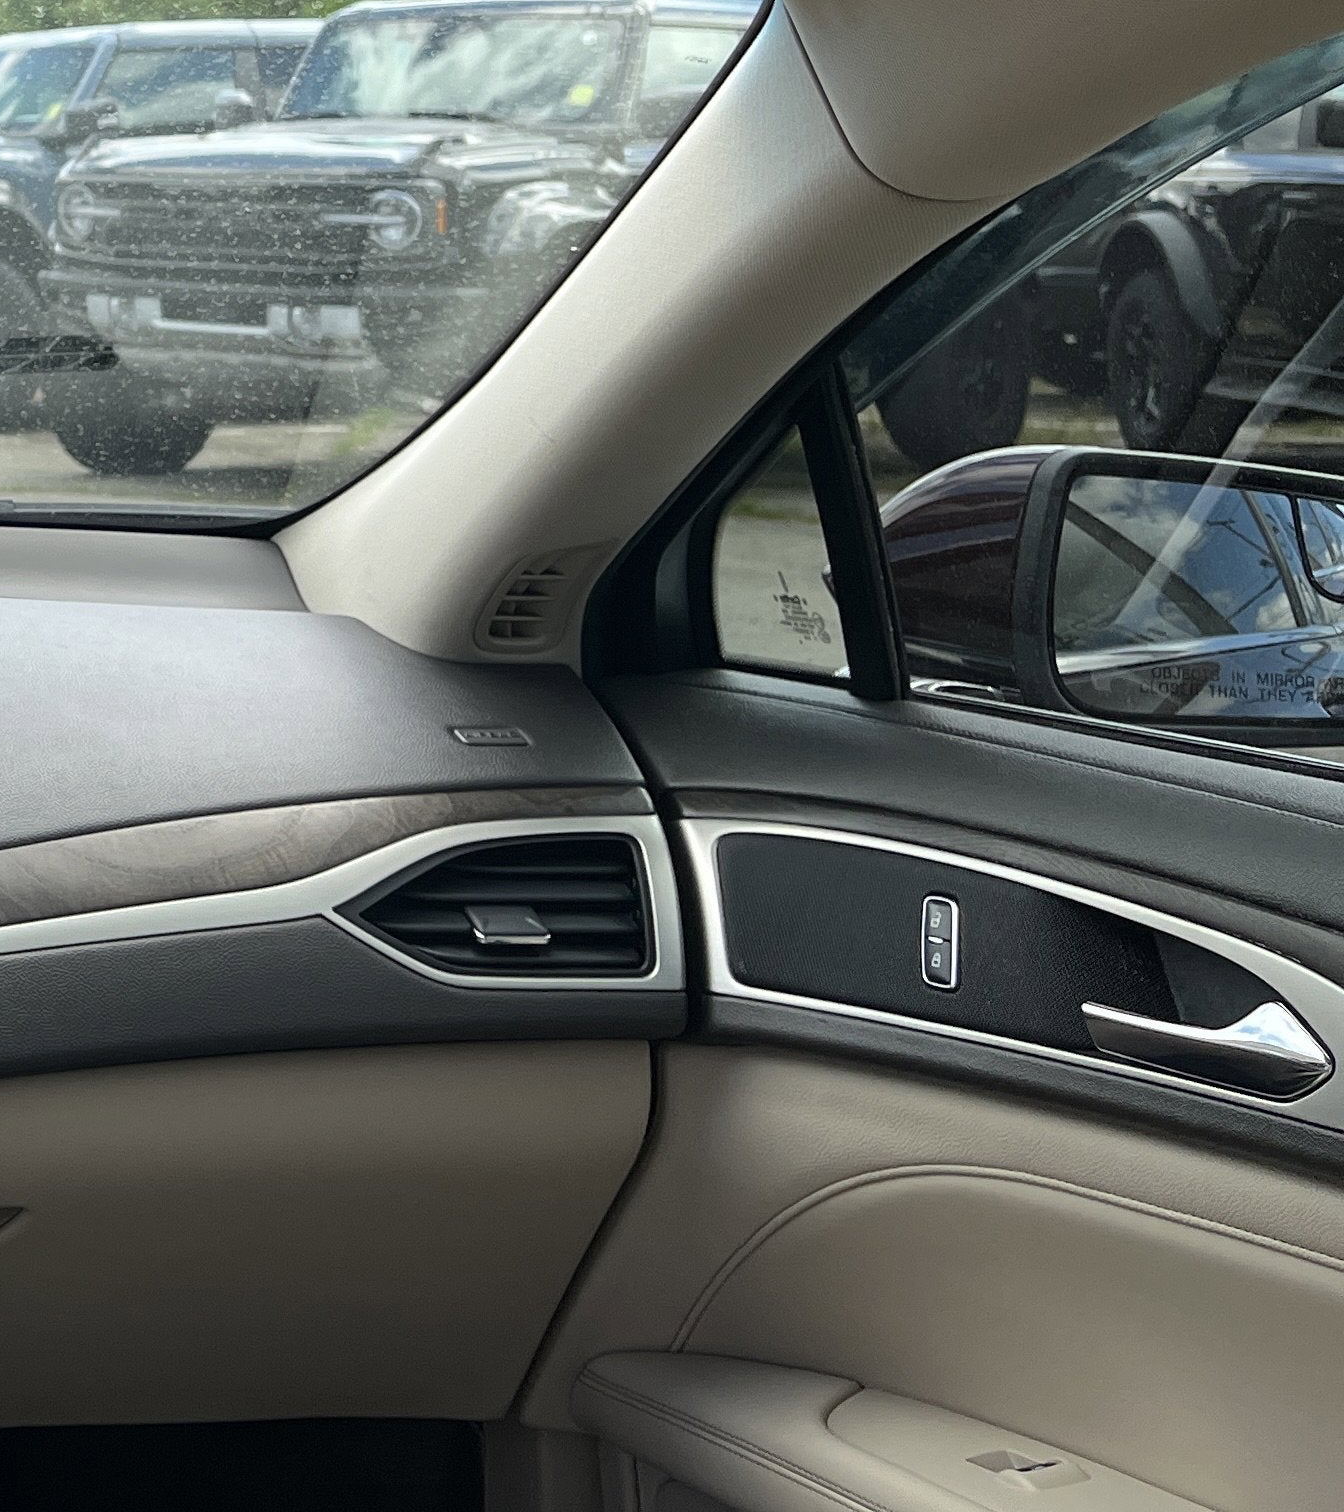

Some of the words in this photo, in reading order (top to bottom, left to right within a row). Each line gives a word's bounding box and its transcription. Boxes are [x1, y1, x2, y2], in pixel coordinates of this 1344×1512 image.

[1151, 665, 1221, 683] OBJECTS
[1232, 669, 1246, 683] IN
[1256, 671, 1315, 688] MIRROR
[1209, 685, 1249, 700] THAN
[1260, 688, 1297, 703] THEY
